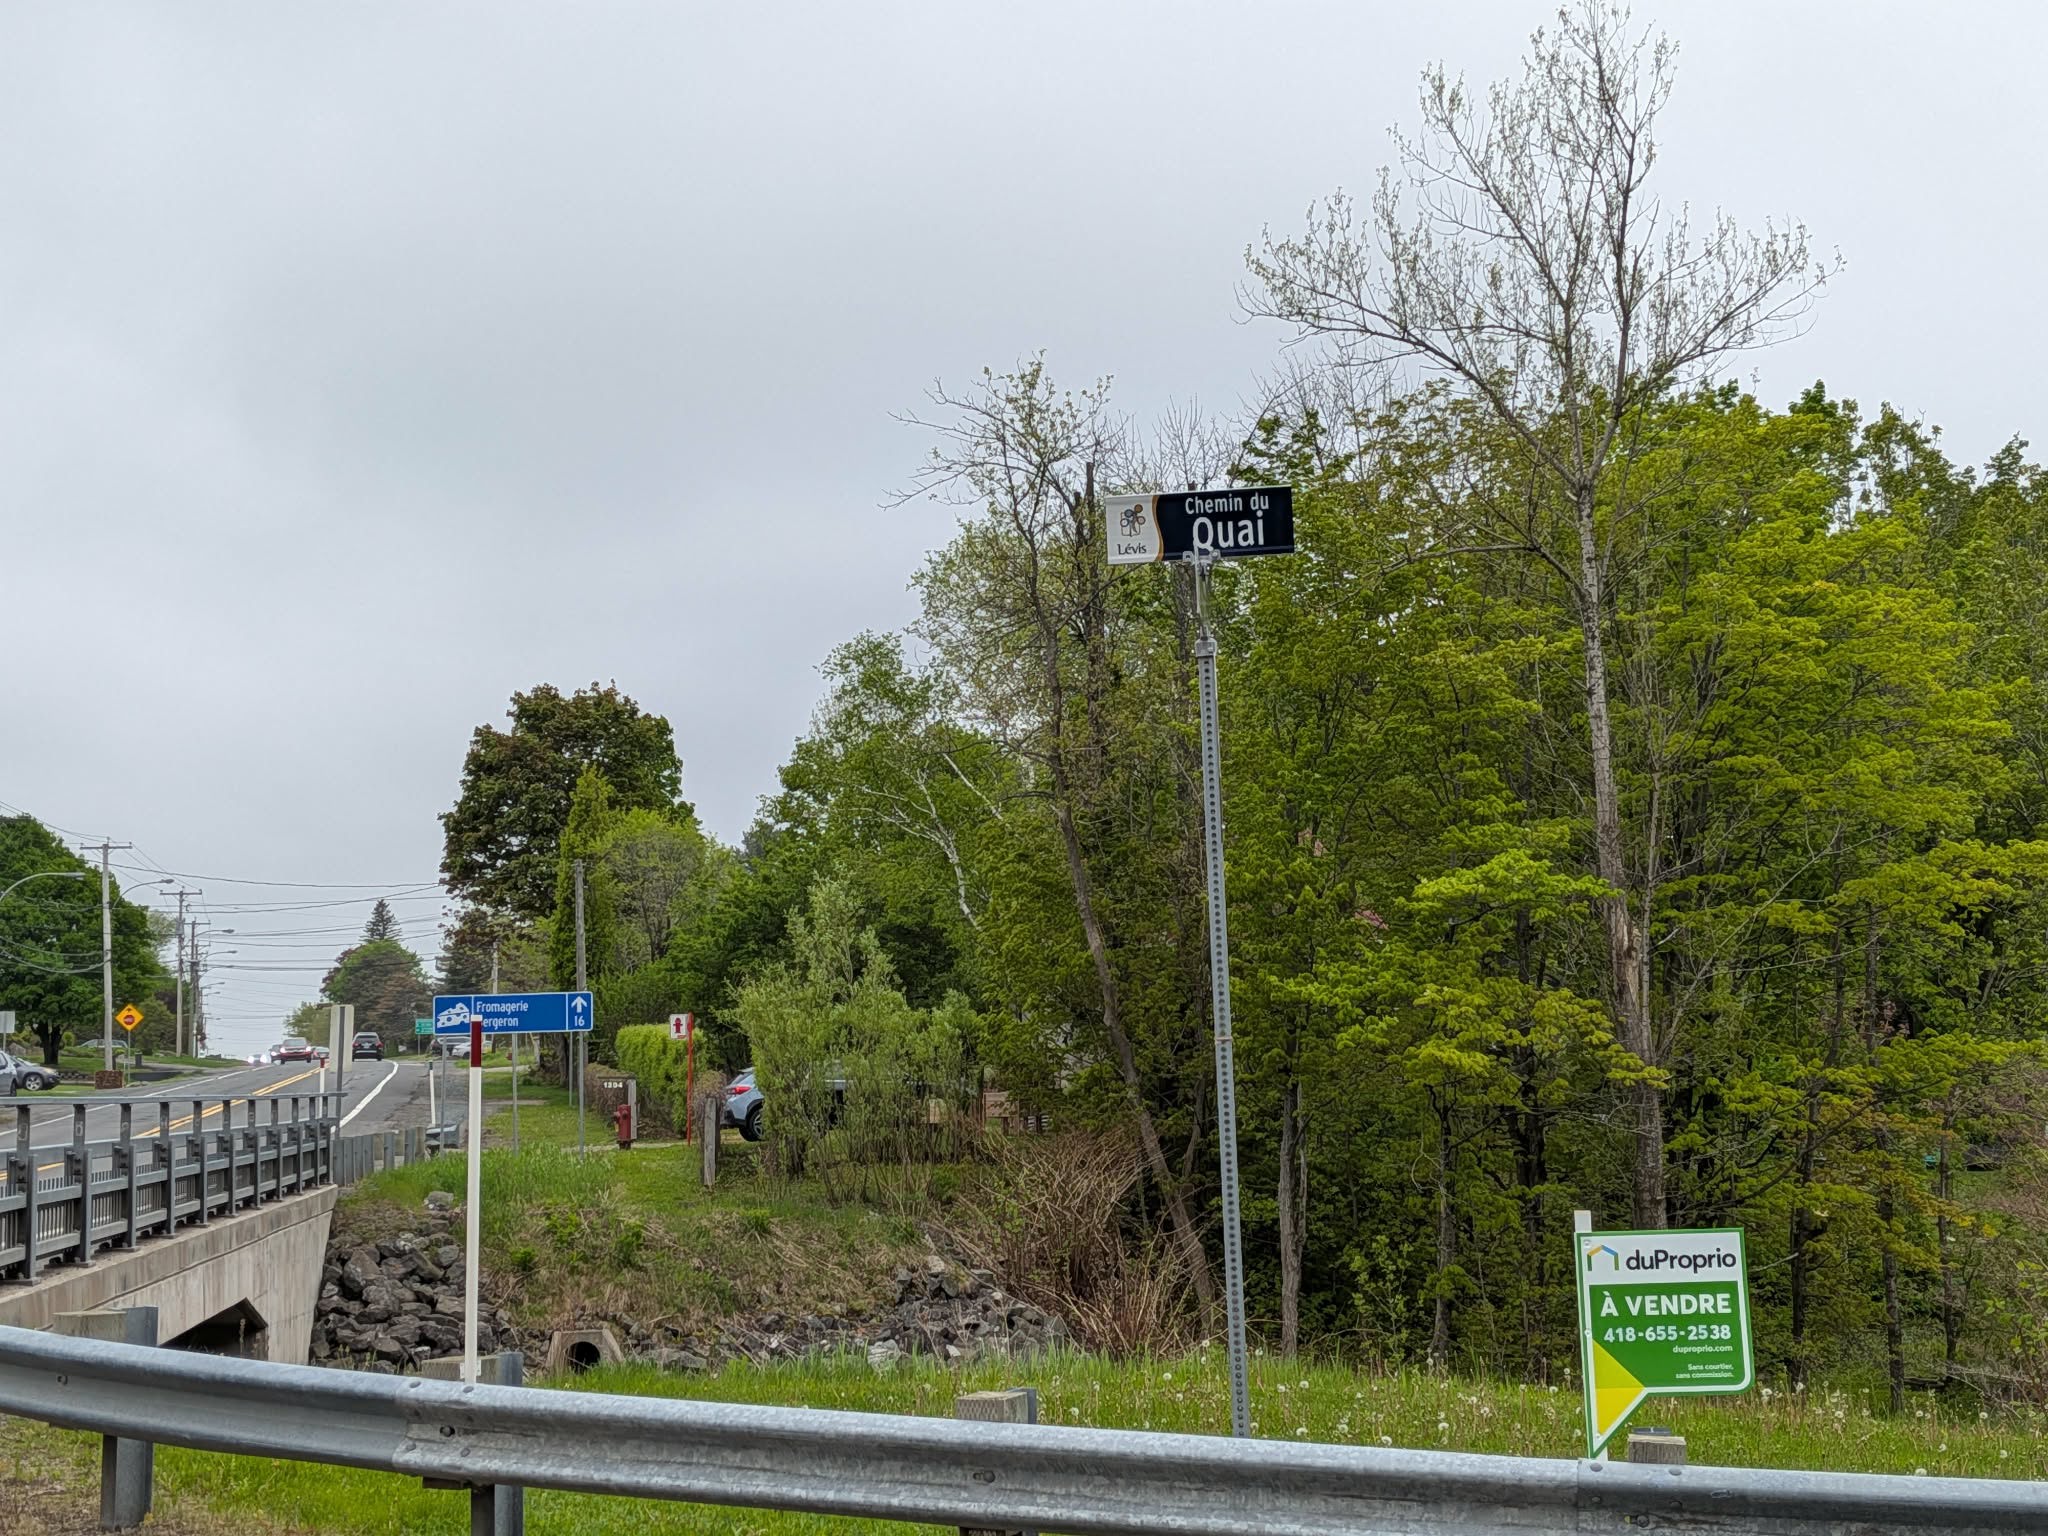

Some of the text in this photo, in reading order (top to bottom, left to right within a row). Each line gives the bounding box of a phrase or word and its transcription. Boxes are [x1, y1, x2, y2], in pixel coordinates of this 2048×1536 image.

[1185, 491, 1270, 515] Chemin du
[1192, 509, 1265, 552] Quai
[1117, 542, 1147, 556] Lévis
[476, 1000, 529, 1015] Fromagerie
[482, 1017, 519, 1030] ergeron
[574, 1015, 585, 1027] 16
[1625, 1247, 1737, 1274] duProprio
[1600, 1291, 1732, 1317] À VENDRE
[1603, 1324, 1732, 1343] 418-655-2538
[1672, 1344, 1734, 1354] duproprio.com
